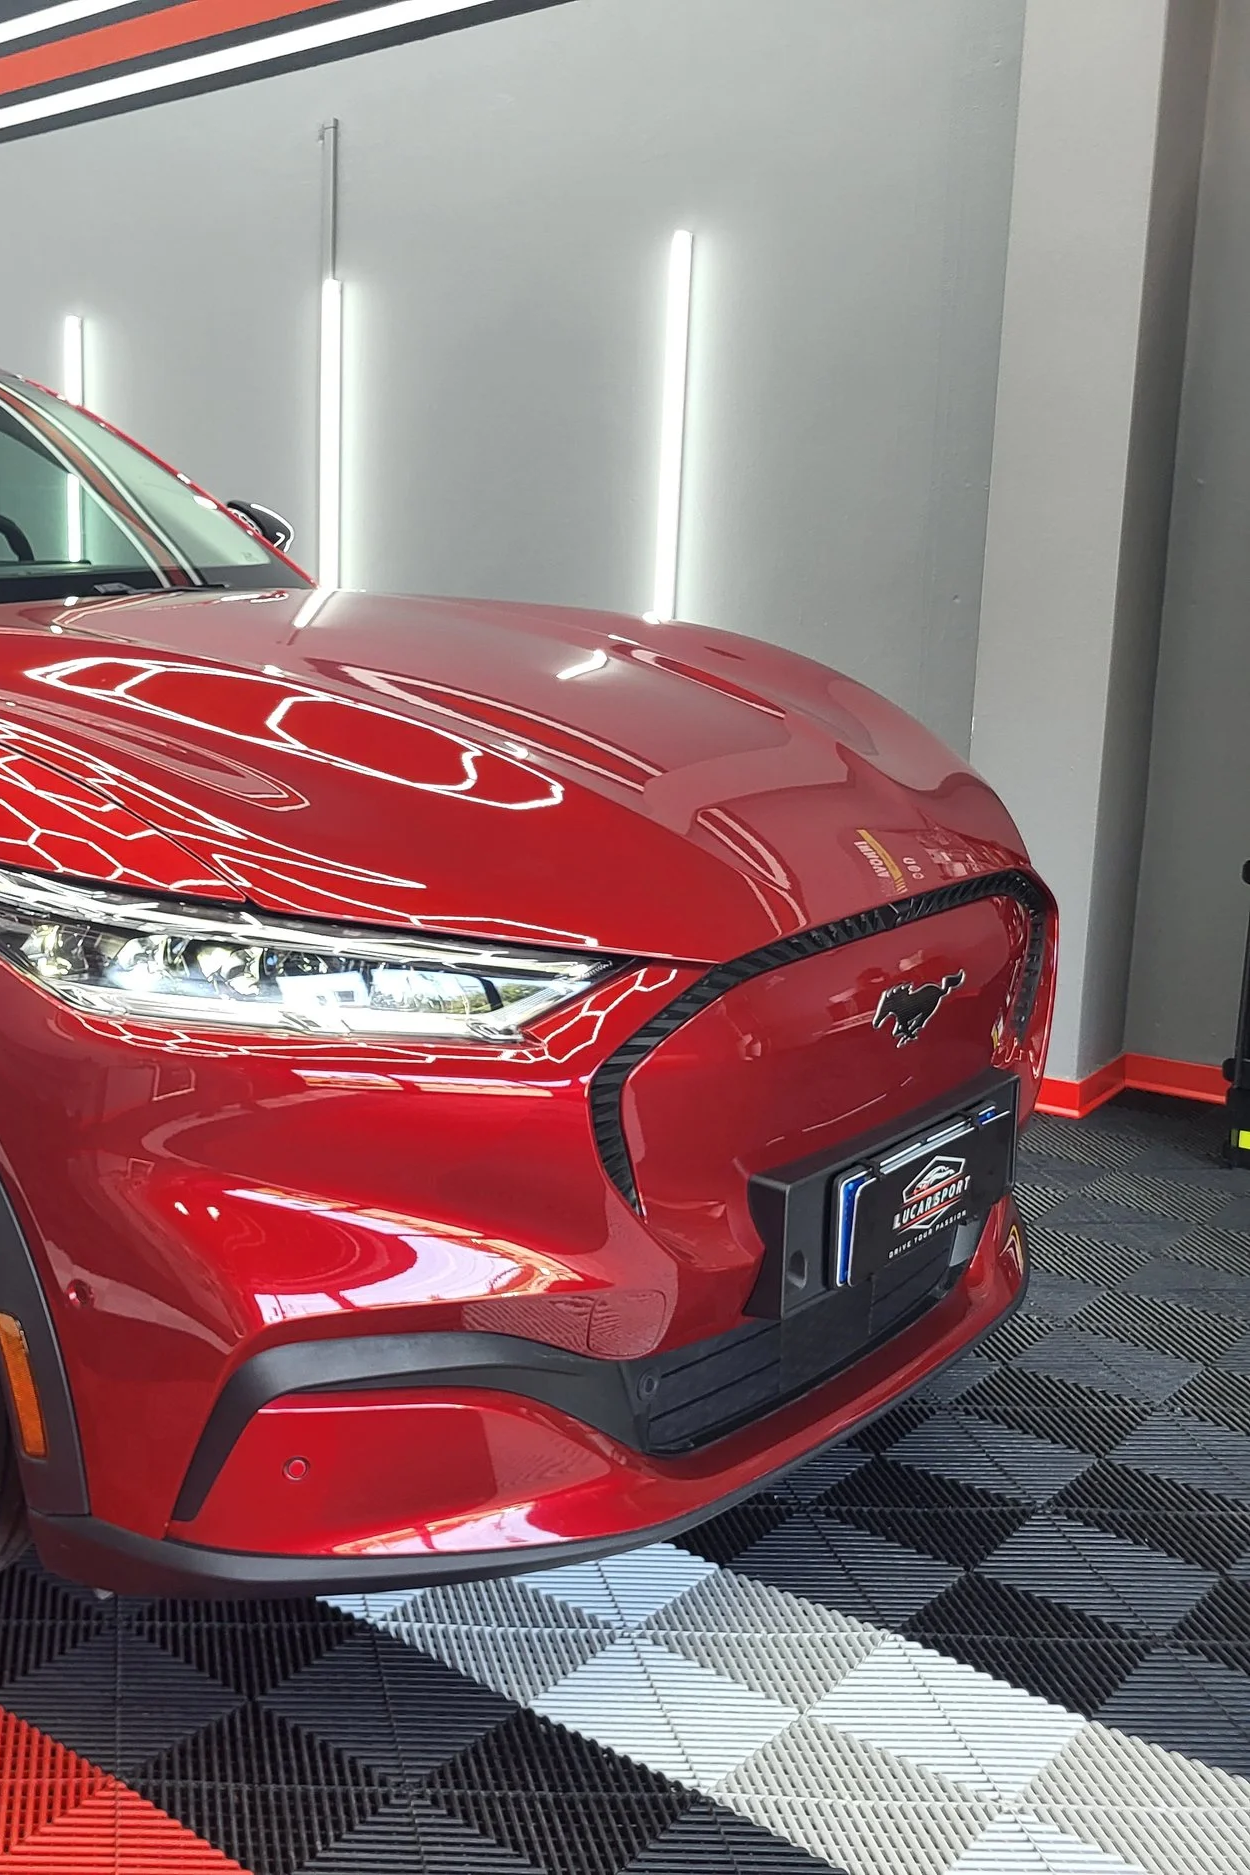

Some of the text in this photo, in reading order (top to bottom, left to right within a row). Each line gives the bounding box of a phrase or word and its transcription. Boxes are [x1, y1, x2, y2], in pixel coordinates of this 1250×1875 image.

[892, 1175, 970, 1230] LUCARSPORT
[888, 1241, 911, 1259] DRIVE
[935, 1210, 966, 1231] PASSION
